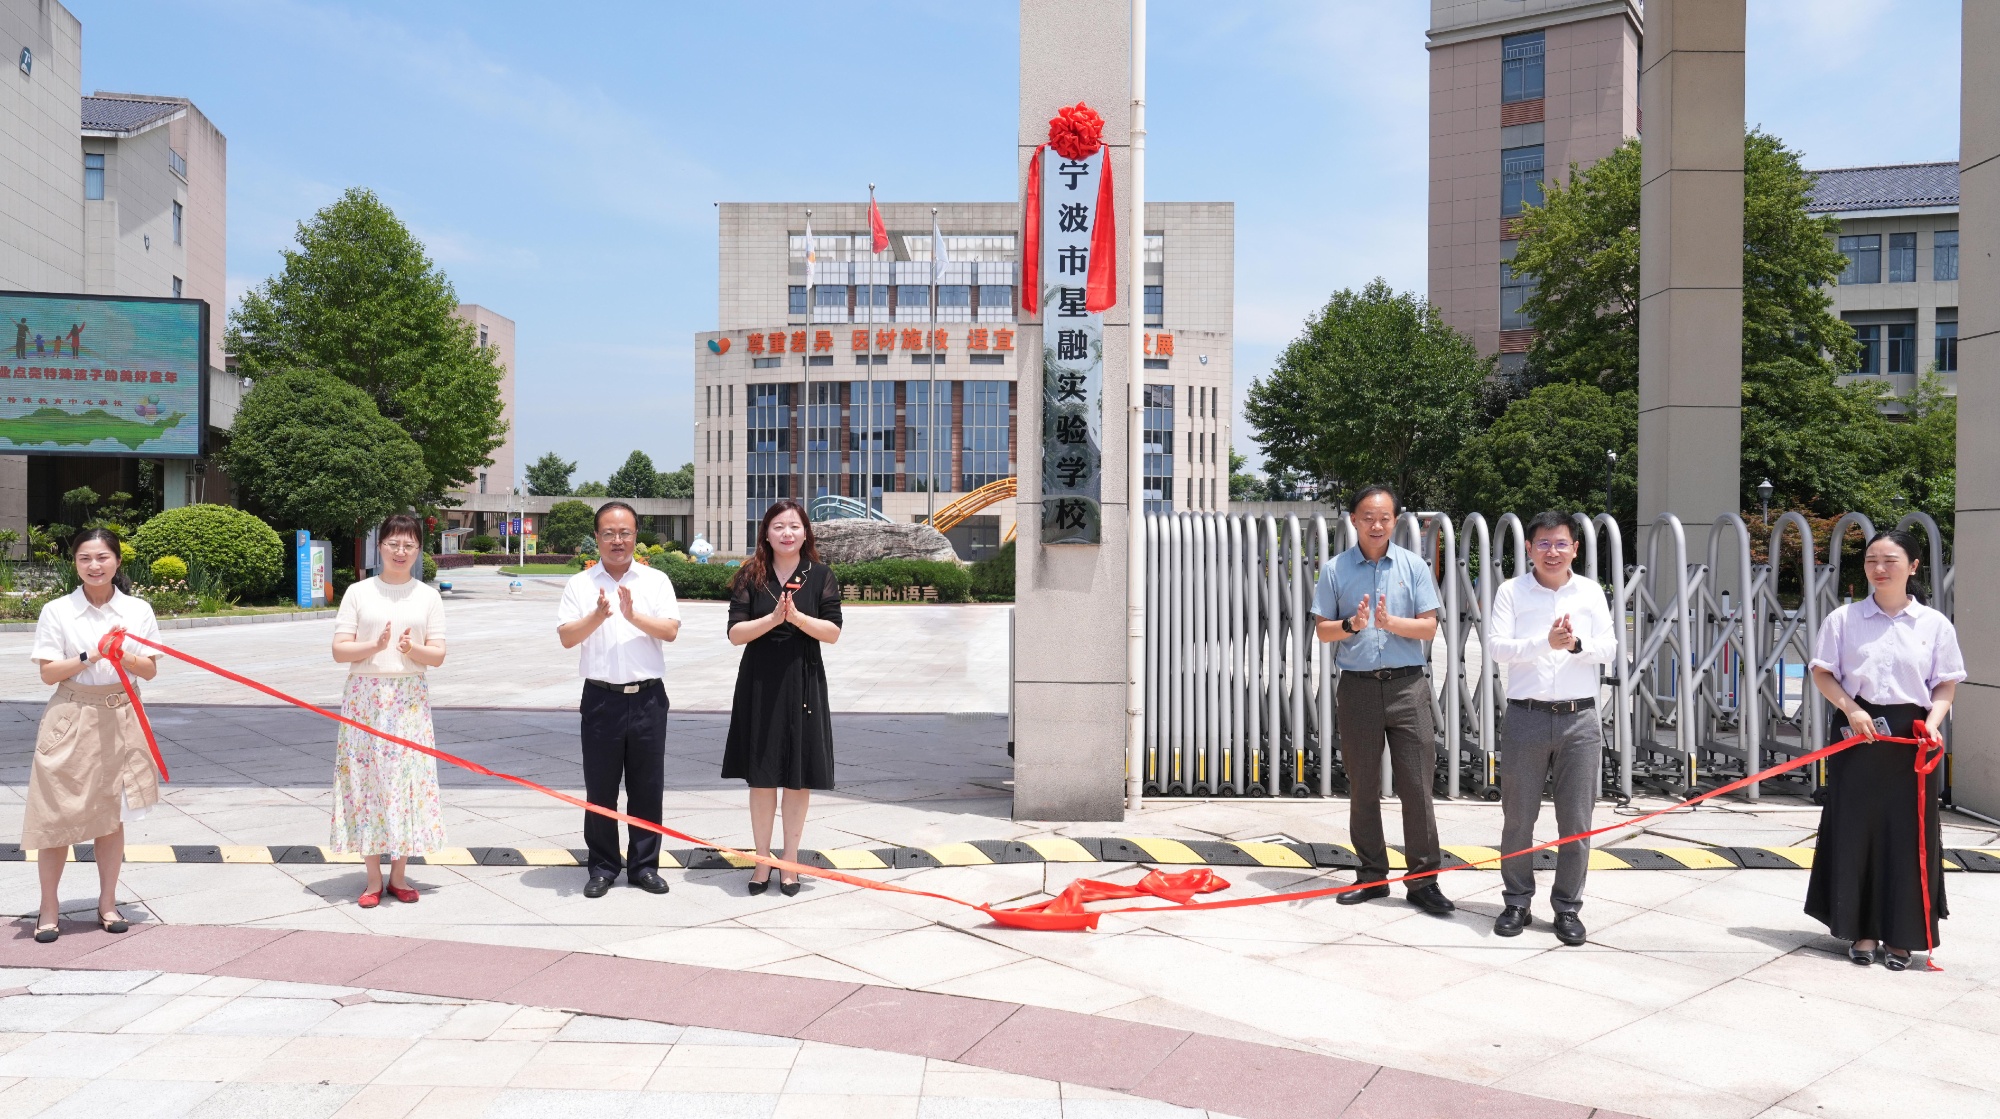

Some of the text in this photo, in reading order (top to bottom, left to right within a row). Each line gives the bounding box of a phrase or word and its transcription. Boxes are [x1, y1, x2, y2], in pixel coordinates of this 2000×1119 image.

[747, 330, 834, 355] 尊重差异
[851, 328, 949, 351] 因材施教
[967, 328, 1016, 351] 适宜
[1056, 160, 1090, 530] 宁波市星融实验学校
[0, 365, 179, 384] 业点亮特殊孩子的美好童年
[0, 396, 124, 408] 特殊教育中心学校
[838, 584, 939, 601] 美丽的语言
